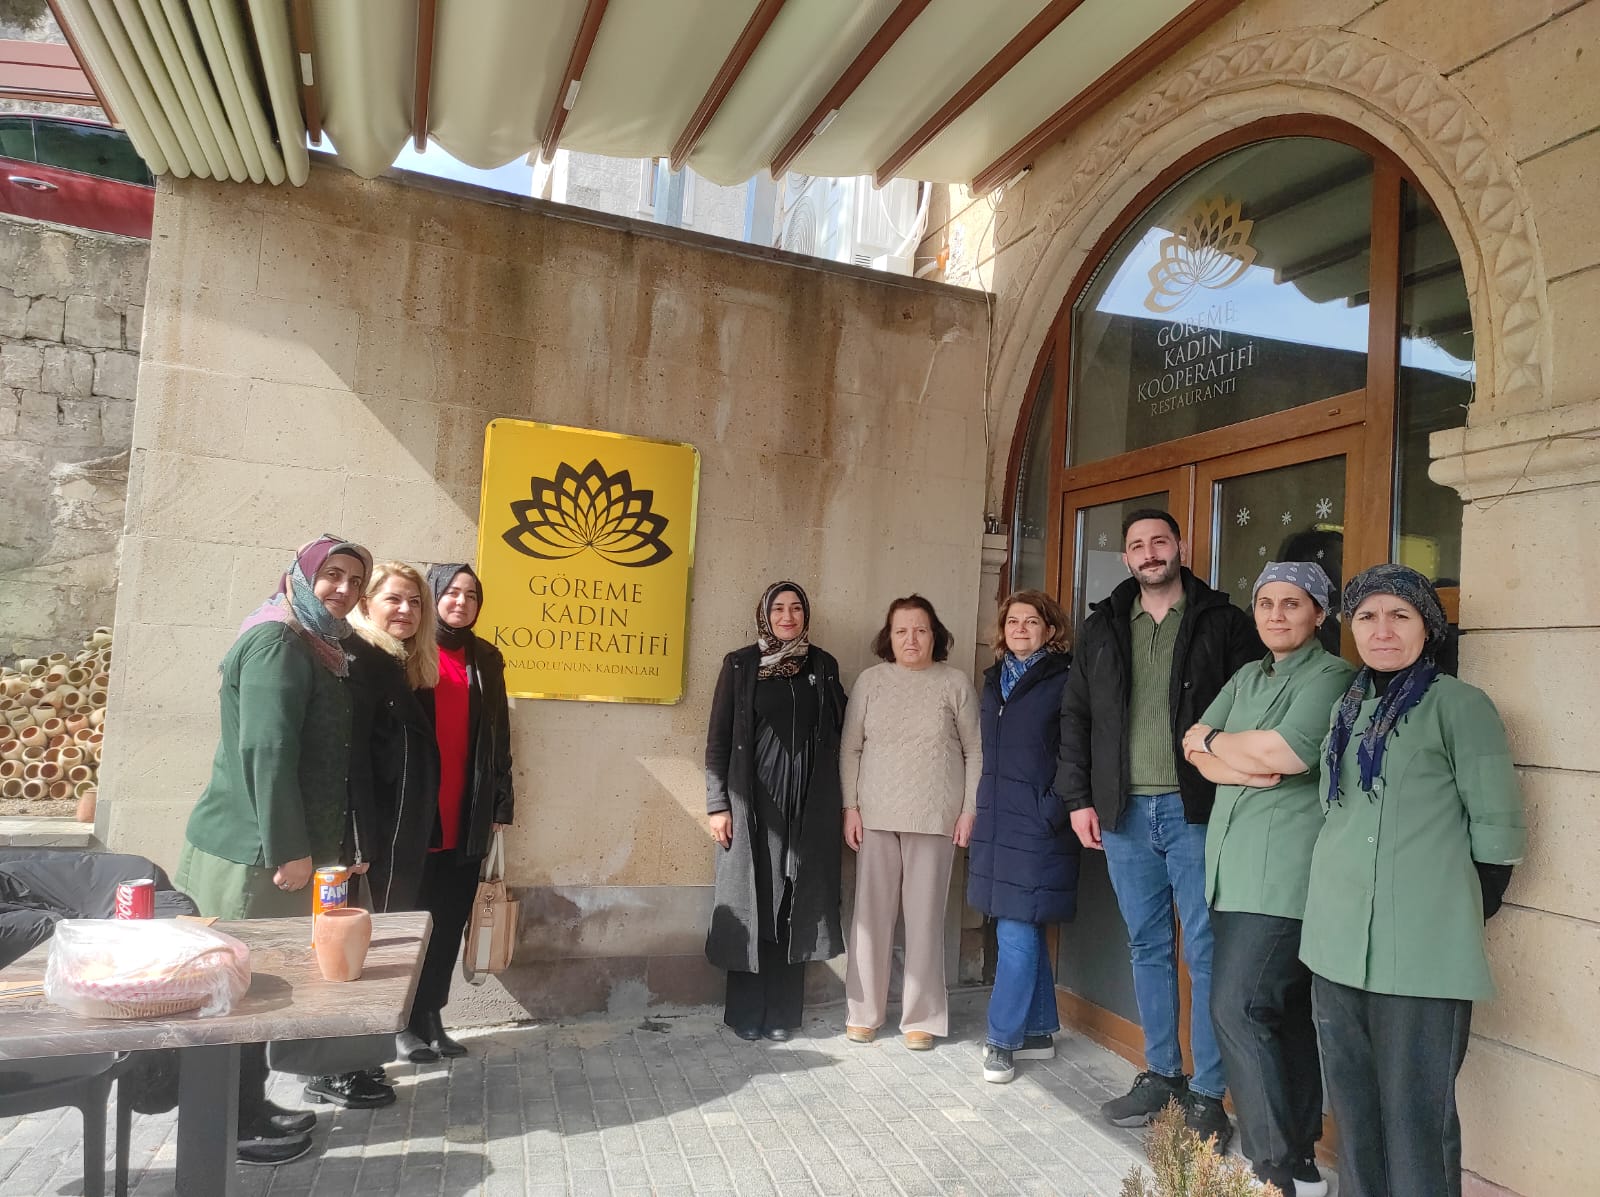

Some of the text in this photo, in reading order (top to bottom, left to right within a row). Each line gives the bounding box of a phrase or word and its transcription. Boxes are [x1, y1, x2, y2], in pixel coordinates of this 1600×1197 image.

[1164, 330, 1223, 370] KADIN
[1137, 341, 1254, 402] KOOPERATİFİ
[1150, 377, 1237, 417] RESTAURANTI
[528, 573, 643, 604] GÖREME
[541, 602, 629, 627] KADIN
[494, 626, 669, 657] KOOPERATİFİ
[503, 658, 660, 677] NADOLU'NUN KADINLARI
